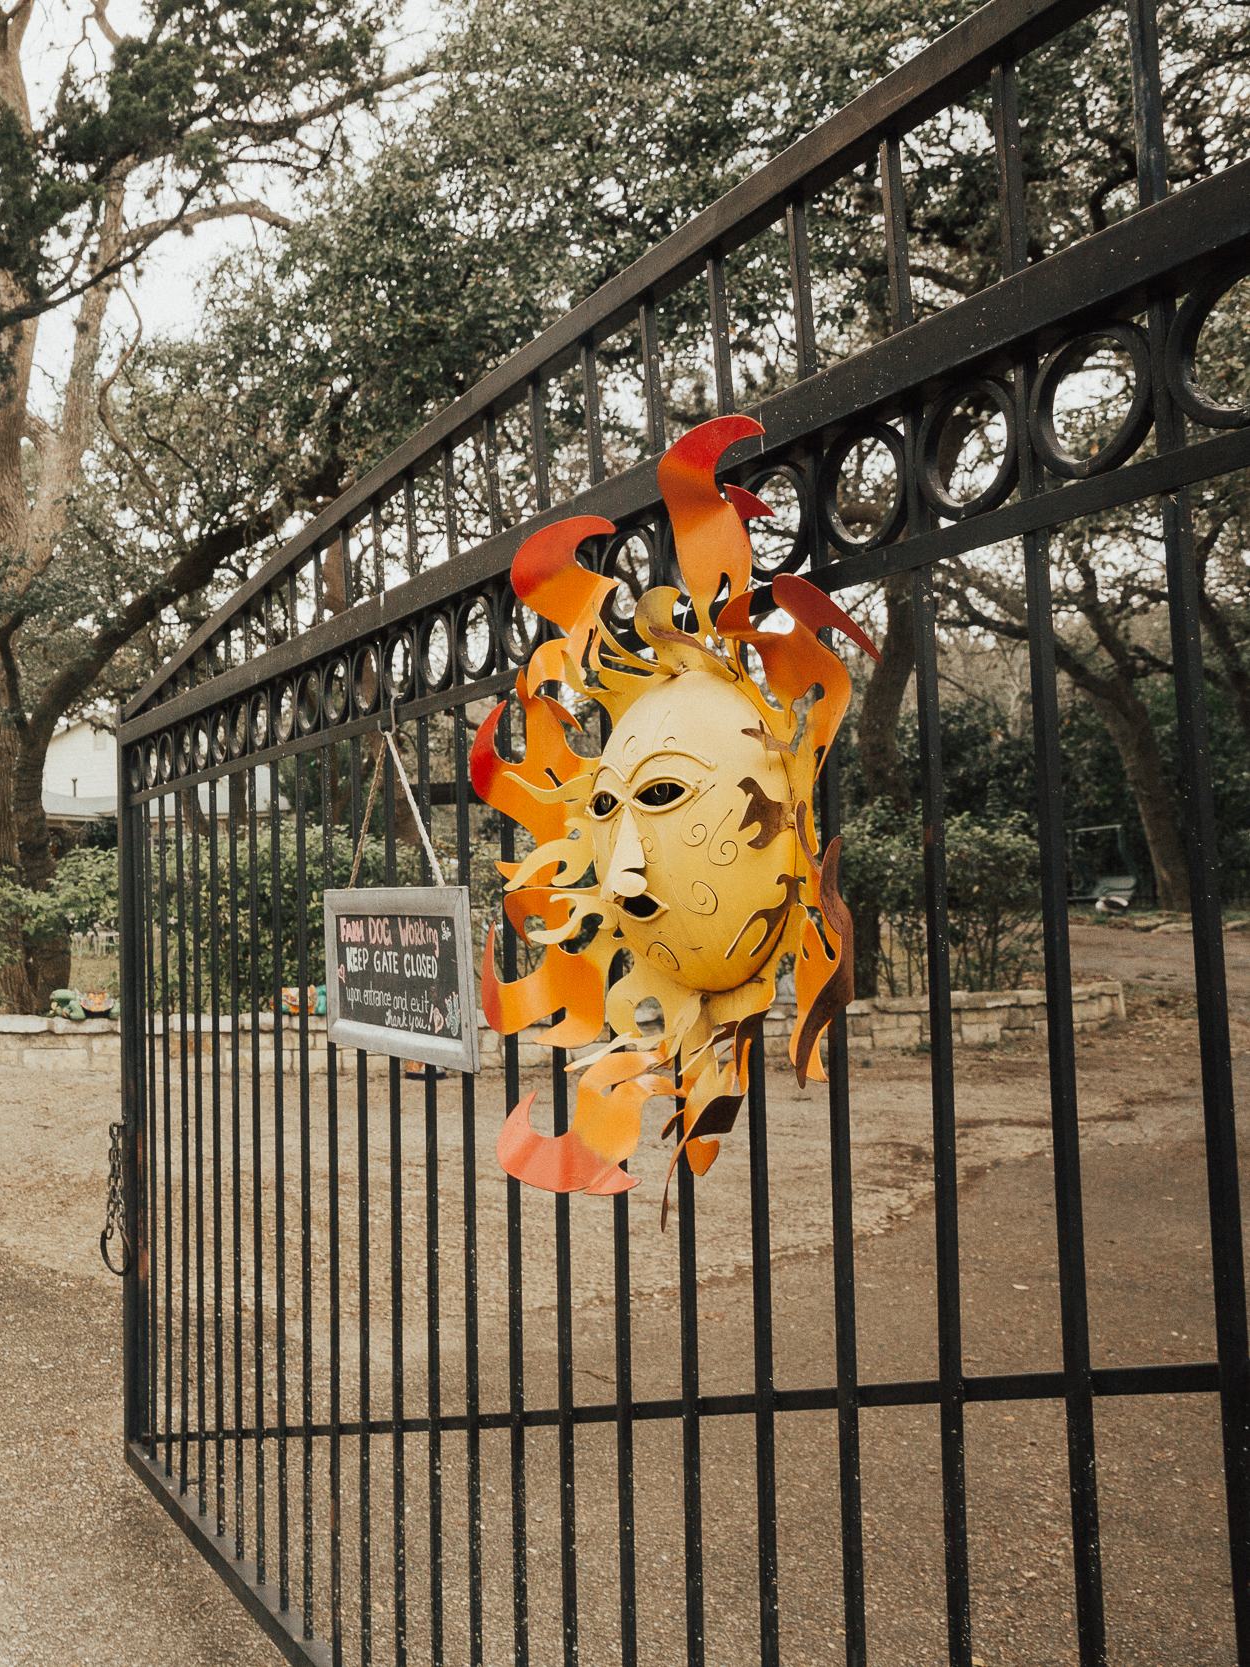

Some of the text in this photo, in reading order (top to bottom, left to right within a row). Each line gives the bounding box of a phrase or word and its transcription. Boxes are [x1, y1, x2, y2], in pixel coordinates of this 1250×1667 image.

[339, 917, 364, 942] FARM
[368, 917, 392, 946] DOG
[346, 947, 438, 979] KEEP GATE CLOSED
[346, 981, 430, 1013] upon entrance and exit
